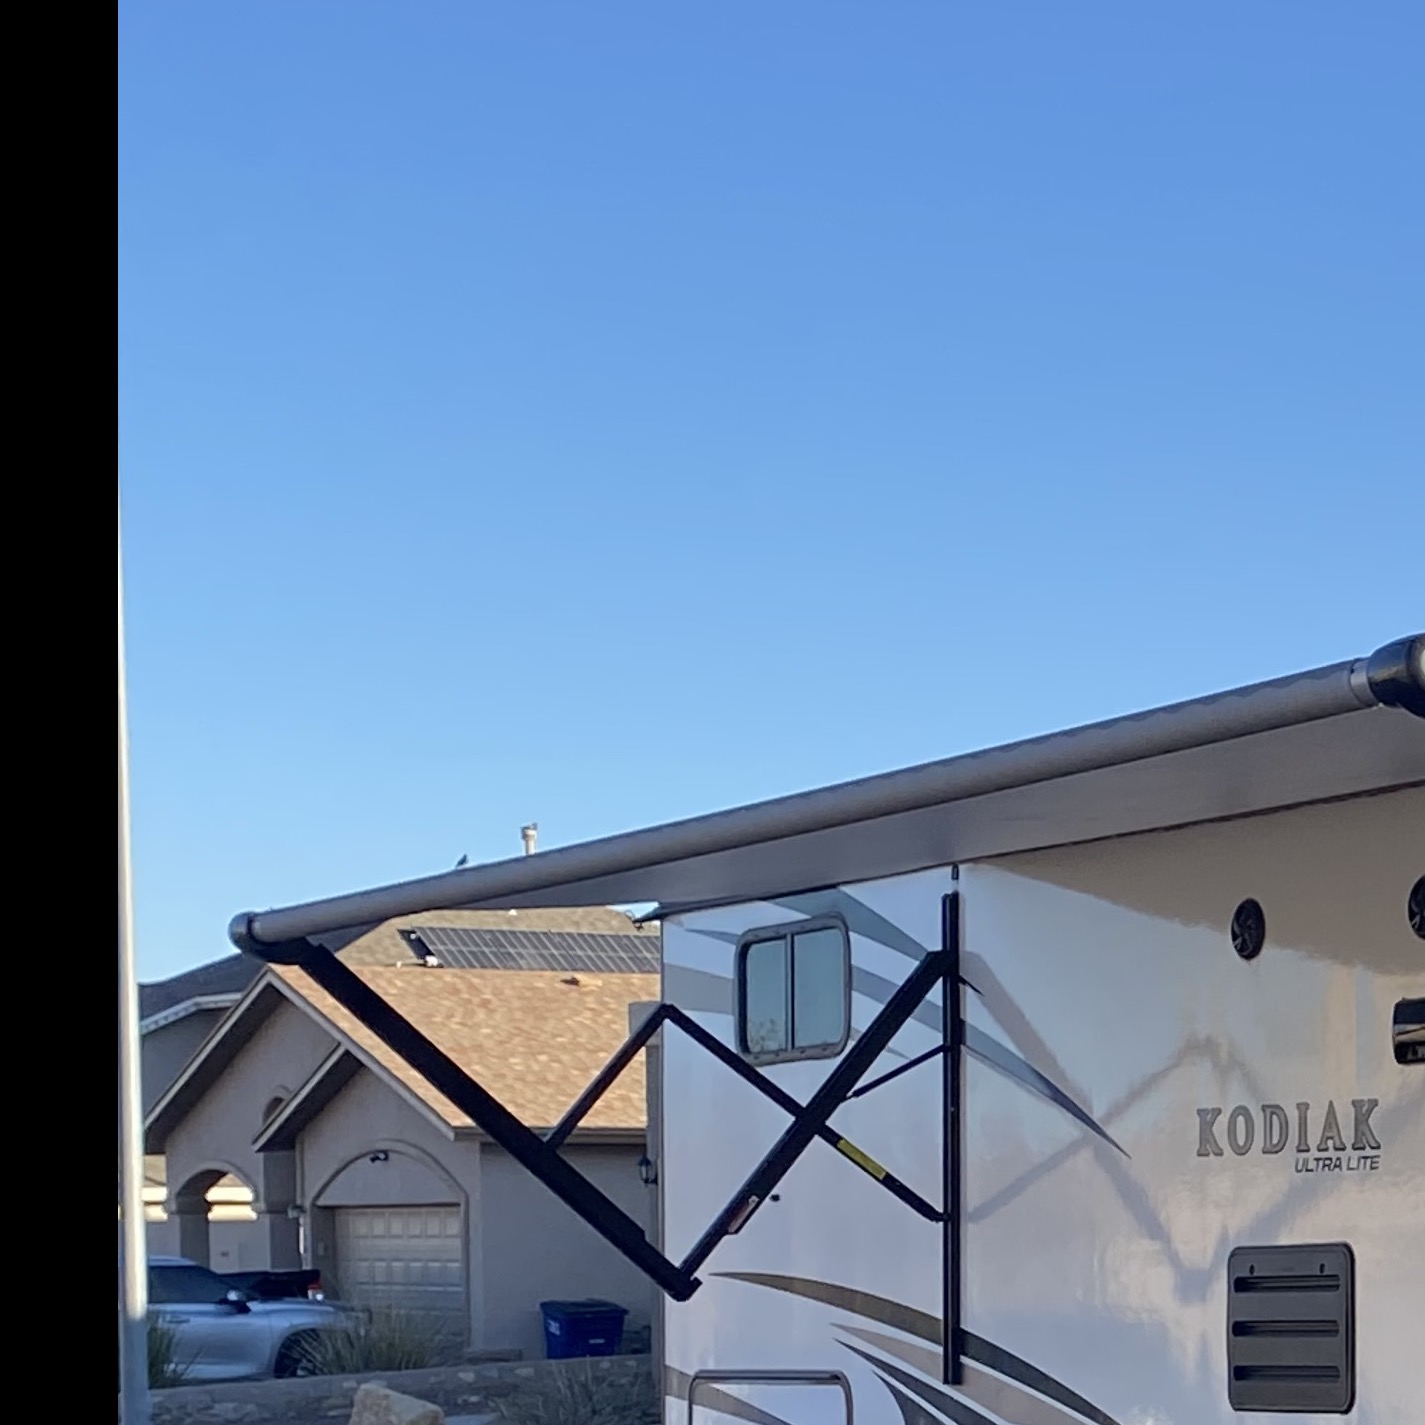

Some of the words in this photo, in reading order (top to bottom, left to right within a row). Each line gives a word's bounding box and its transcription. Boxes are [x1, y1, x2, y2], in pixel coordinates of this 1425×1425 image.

[1195, 1098, 1382, 1157] KODIAK
[1294, 1156, 1343, 1174] ULTRA
[1346, 1154, 1382, 1172] LITE
